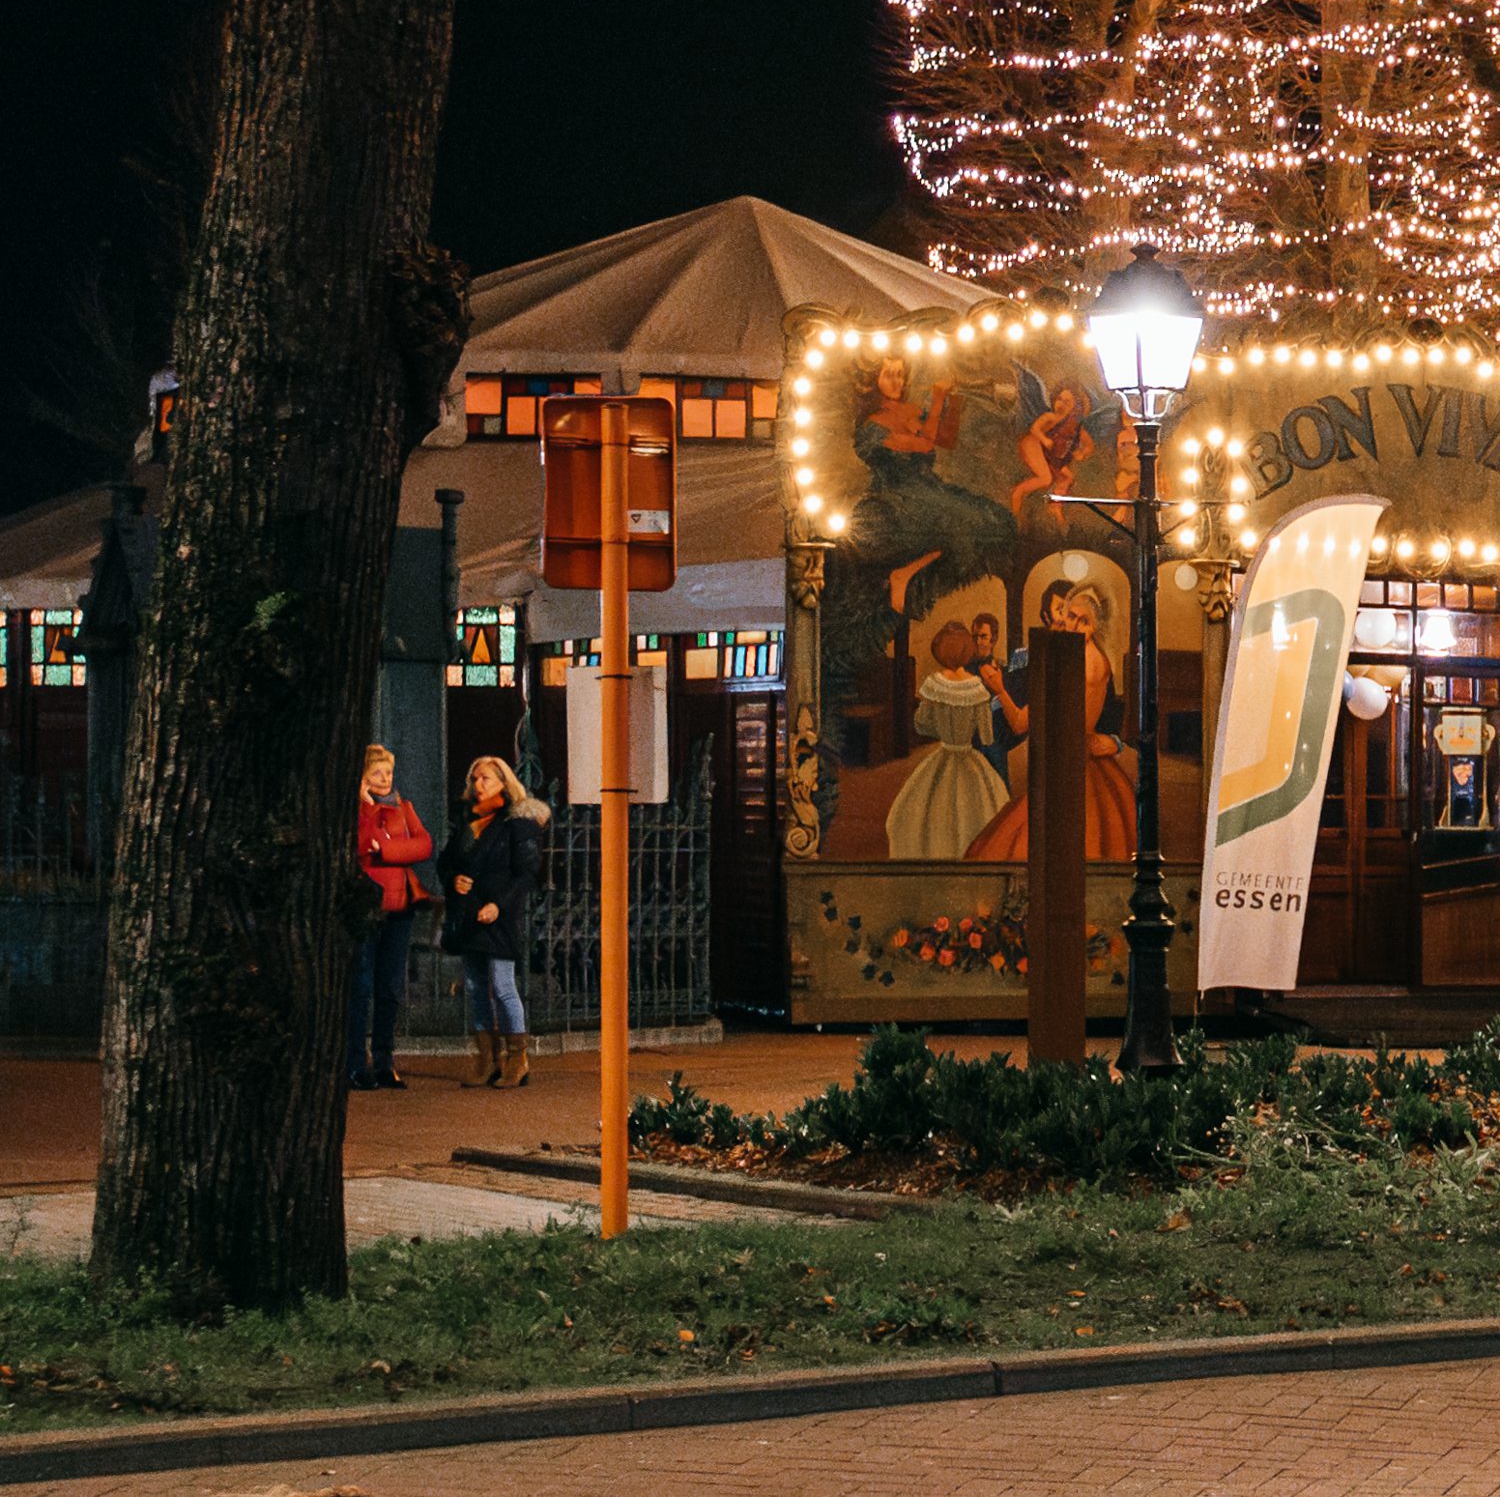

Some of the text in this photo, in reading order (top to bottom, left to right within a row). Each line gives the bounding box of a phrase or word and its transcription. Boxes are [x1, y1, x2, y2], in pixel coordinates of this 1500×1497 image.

[1241, 386, 1379, 500] BON
[1216, 872, 1304, 890] GEMEENTE
[1215, 889, 1302, 912] essen
